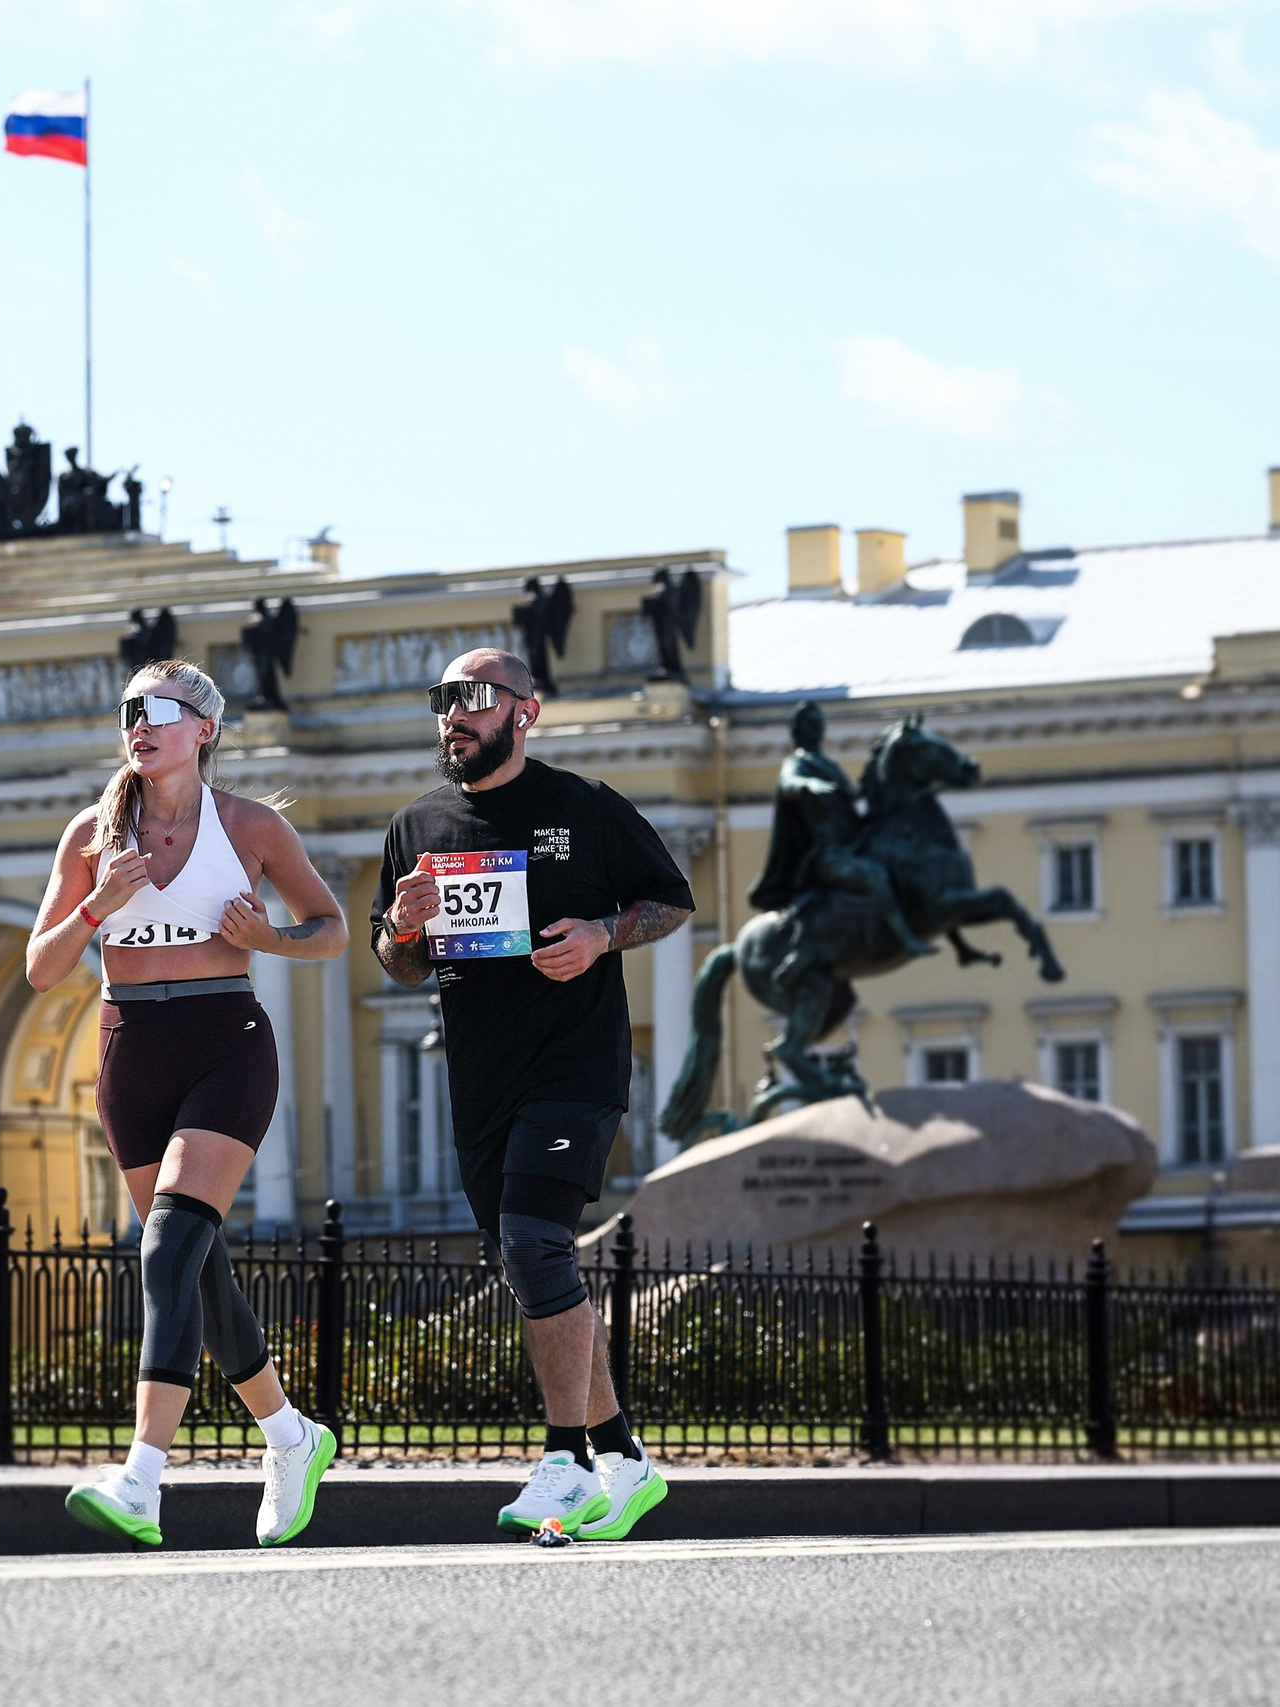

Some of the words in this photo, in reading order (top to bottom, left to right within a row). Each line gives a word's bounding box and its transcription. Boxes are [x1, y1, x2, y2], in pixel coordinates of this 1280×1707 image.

[534, 829, 555, 837] MAKE
[534, 845, 555, 853] MAKE
[480, 858, 495, 867] 21,1
[443, 881, 502, 915] 537
[450, 915, 499, 928] НИКОЛАЙ
